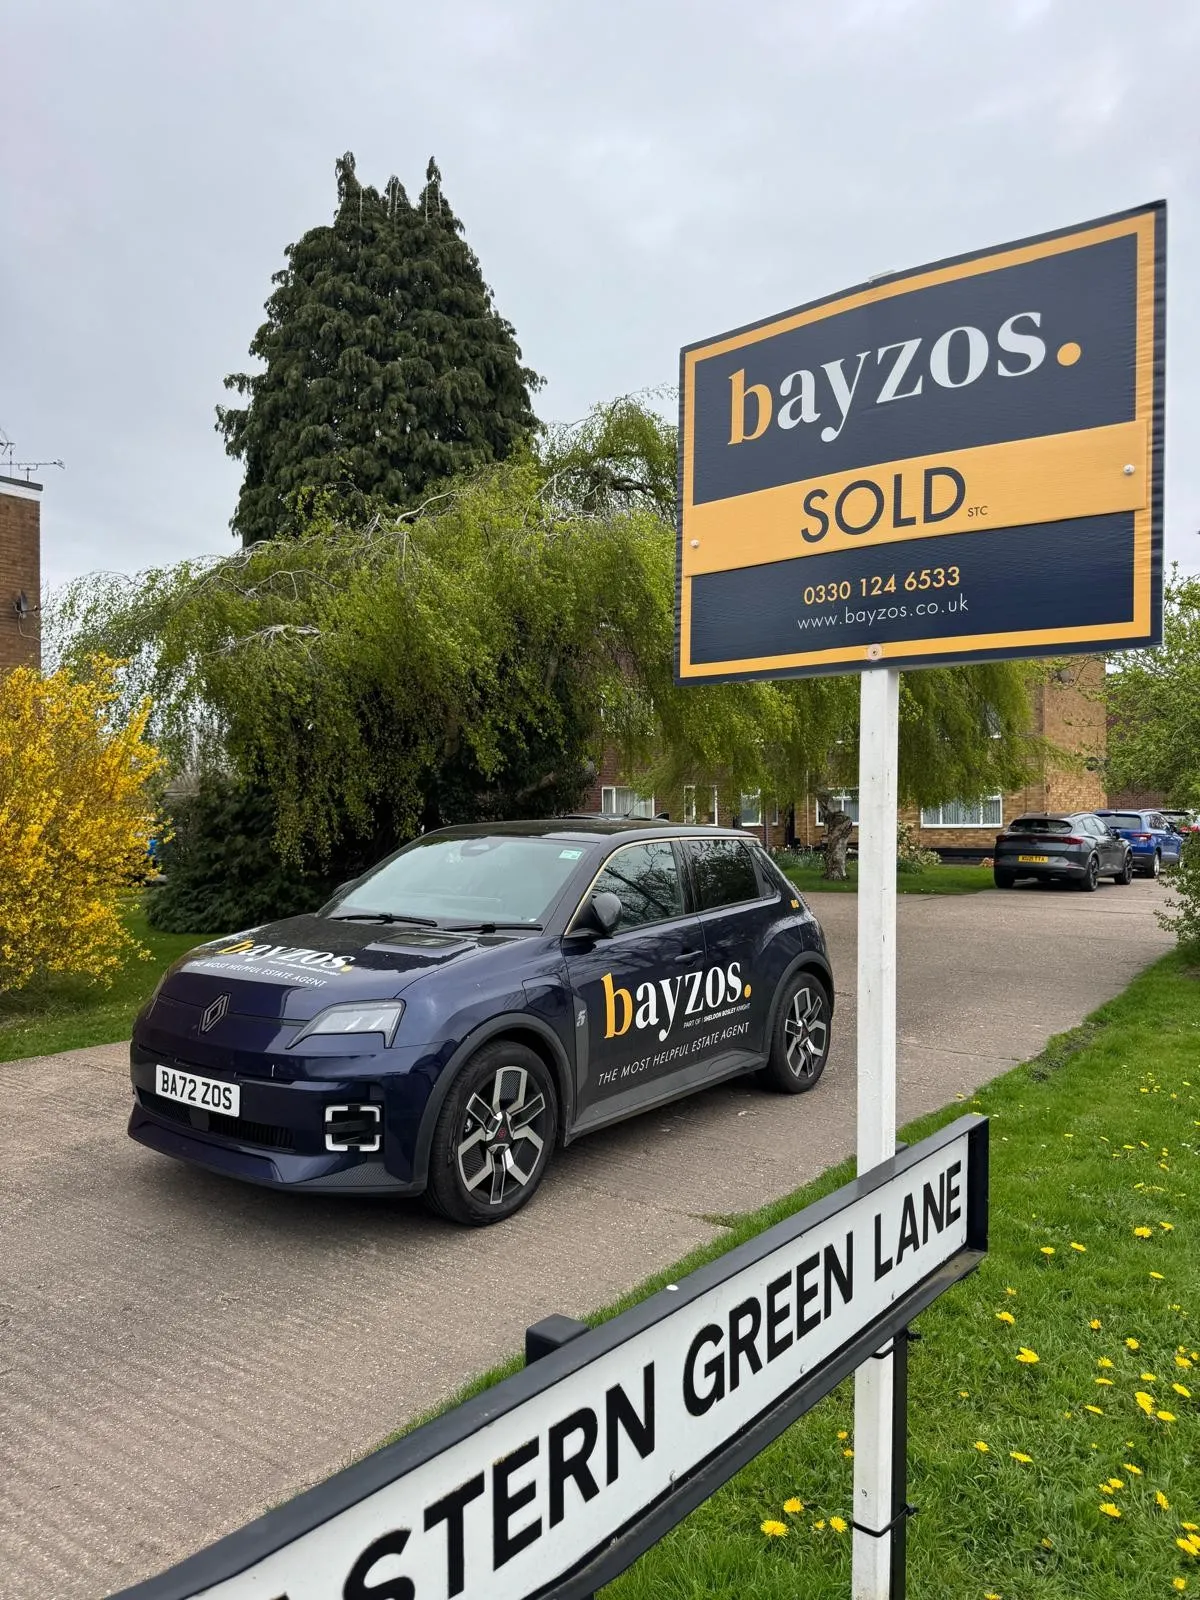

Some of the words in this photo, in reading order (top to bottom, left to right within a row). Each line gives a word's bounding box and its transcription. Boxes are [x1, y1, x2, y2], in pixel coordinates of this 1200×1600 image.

[727, 311, 1082, 446] bayzos.
[801, 466, 966, 543] SOLD
[967, 506, 989, 517] STC
[797, 593, 969, 630] www.bayzos.co.uk
[804, 581, 851, 605] 0330
[860, 574, 897, 597] 124
[904, 566, 961, 591] 6533
[227, 962, 262, 975] HELPFUL
[261, 968, 293, 980] ESTATE
[292, 974, 328, 988] AGENT
[601, 961, 752, 1042] bayzos.
[683, 1019, 695, 1029] PART
[598, 1068, 618, 1086] THE
[620, 1057, 651, 1078] MOST
[652, 1044, 689, 1067] HELPFUL
[692, 1031, 720, 1052] ESTATE
[719, 1021, 750, 1041] AGENT
[161, 1070, 197, 1101] BA72
[201, 1081, 233, 1110] ZOS
[269, 1363, 656, 1600] STERN
[682, 1230, 855, 1418] GREEN
[873, 1159, 963, 1282] LANE
